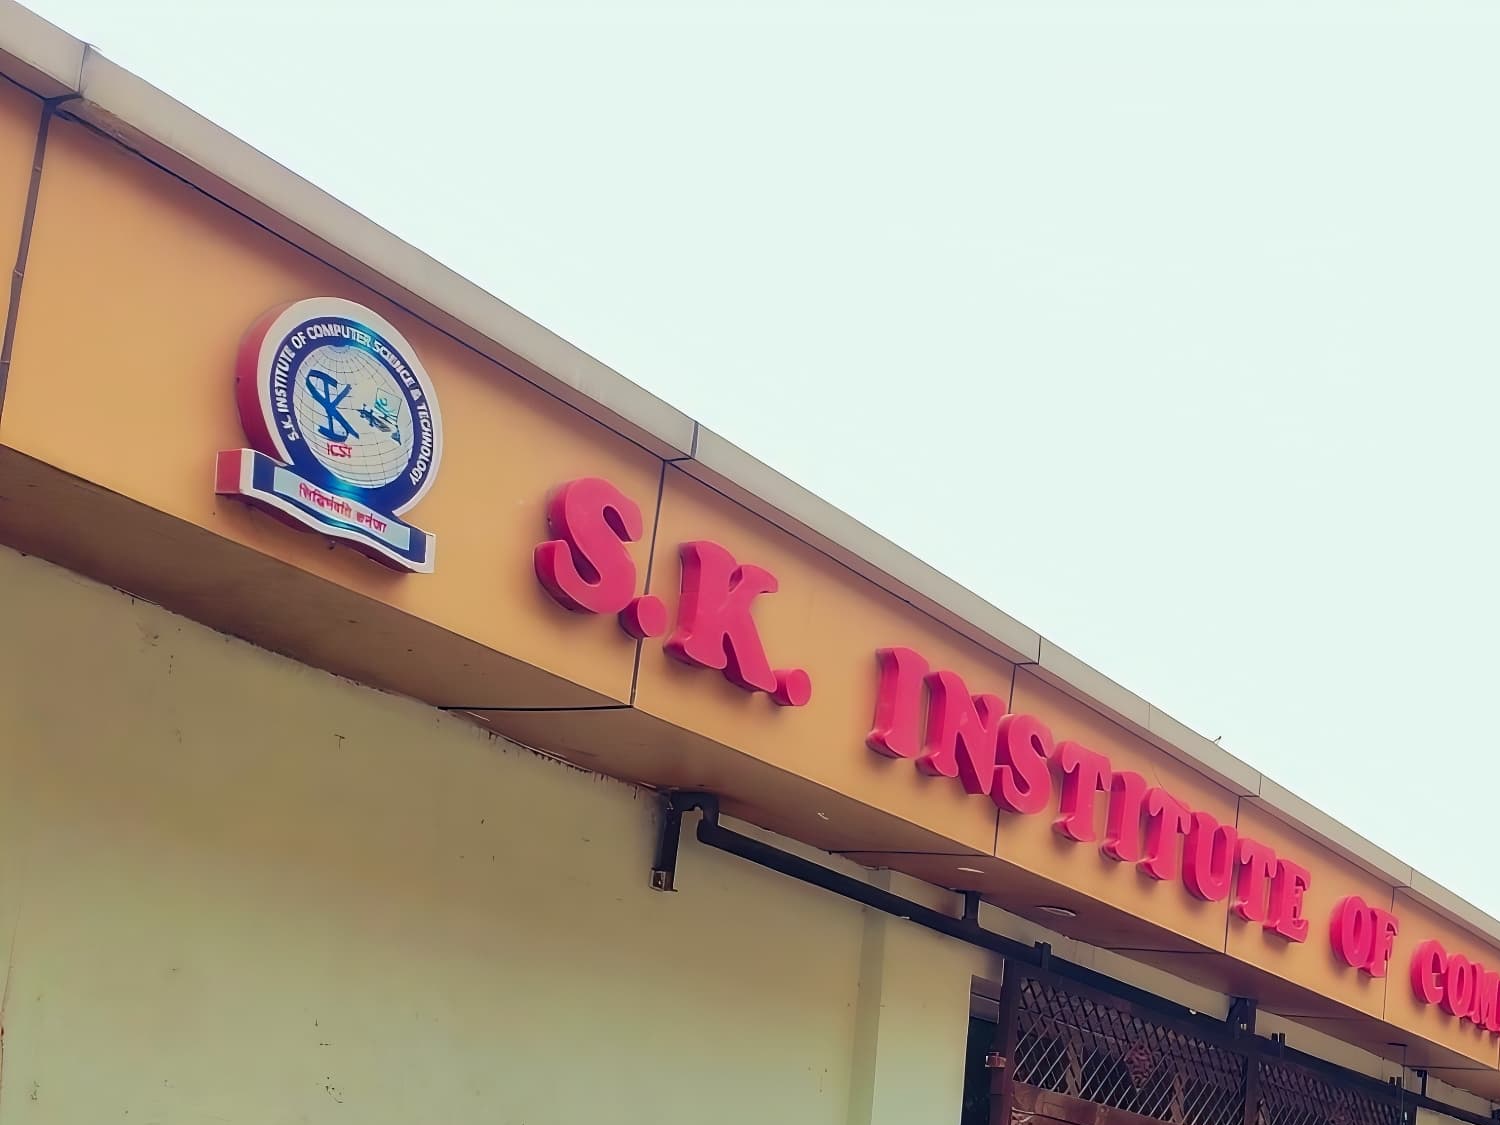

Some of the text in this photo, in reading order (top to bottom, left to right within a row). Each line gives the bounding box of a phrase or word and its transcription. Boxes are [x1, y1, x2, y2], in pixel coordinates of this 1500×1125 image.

[275, 349, 296, 412] INSTITUTE
[292, 332, 308, 349] OF
[306, 323, 373, 347] COMPUTER
[410, 402, 433, 486] TECHNOLOGY
[327, 442, 352, 458] ICST
[534, 477, 812, 707] S.K.
[866, 647, 1311, 943] INSTITUTE
[1330, 895, 1399, 978] OF
